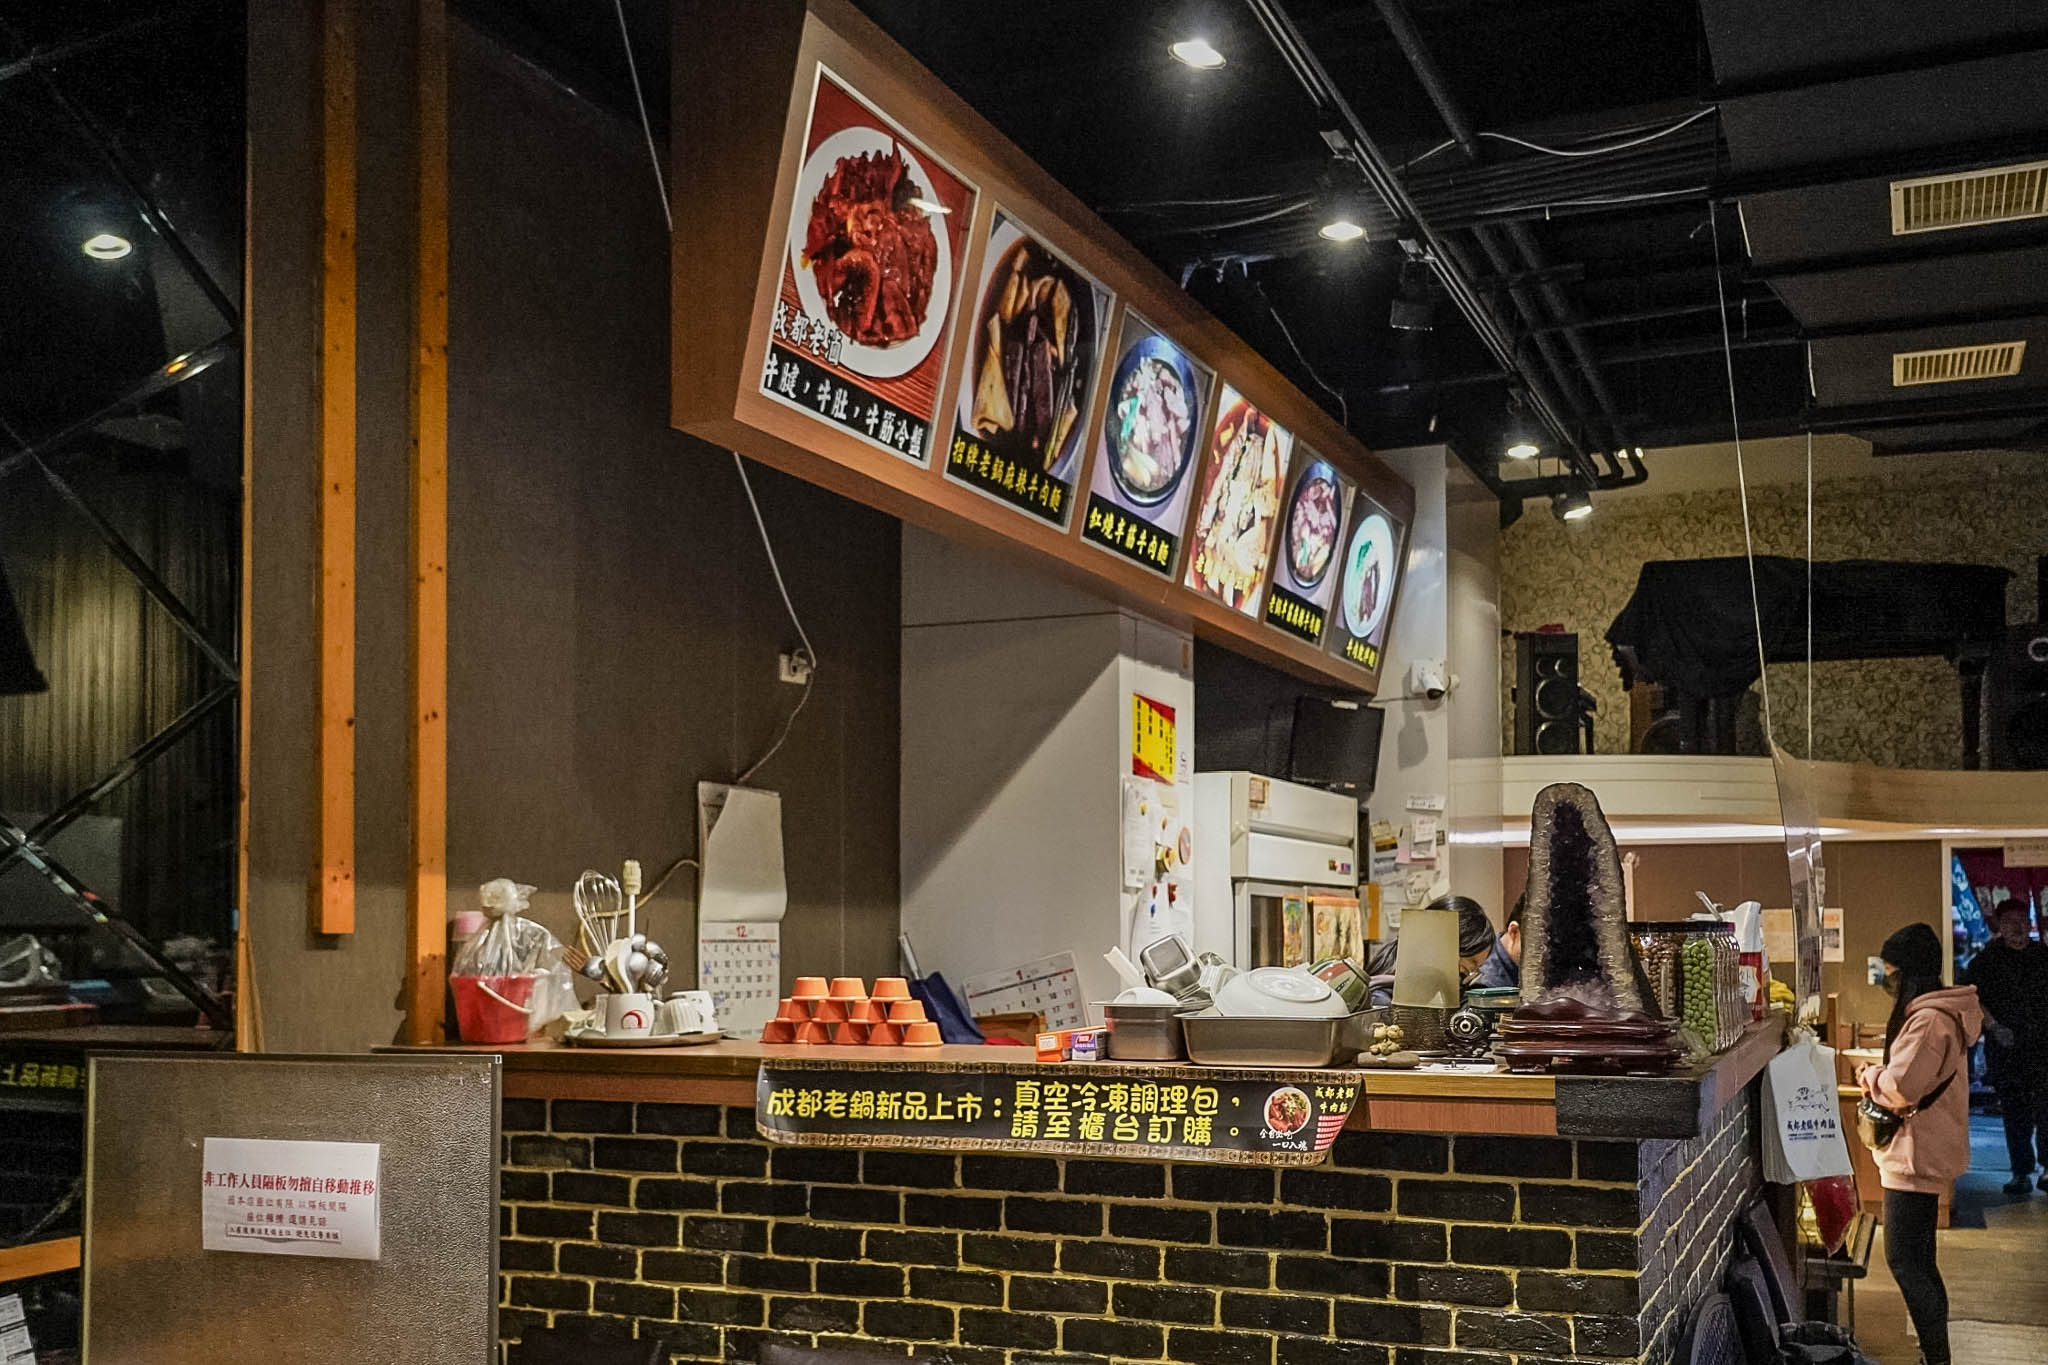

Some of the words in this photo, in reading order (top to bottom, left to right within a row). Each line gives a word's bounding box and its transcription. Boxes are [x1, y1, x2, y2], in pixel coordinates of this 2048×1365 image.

[736, 925, 747, 937] 12
[766, 1088, 1002, 1122] 成都老鍋新品上市：
[1014, 1080, 1240, 1115] 真空冷凍調理包，
[1011, 1109, 1240, 1146] 請至櫃台訂購。
[203, 1171, 375, 1195] 非工作人員隔板勿擅自移動推移
